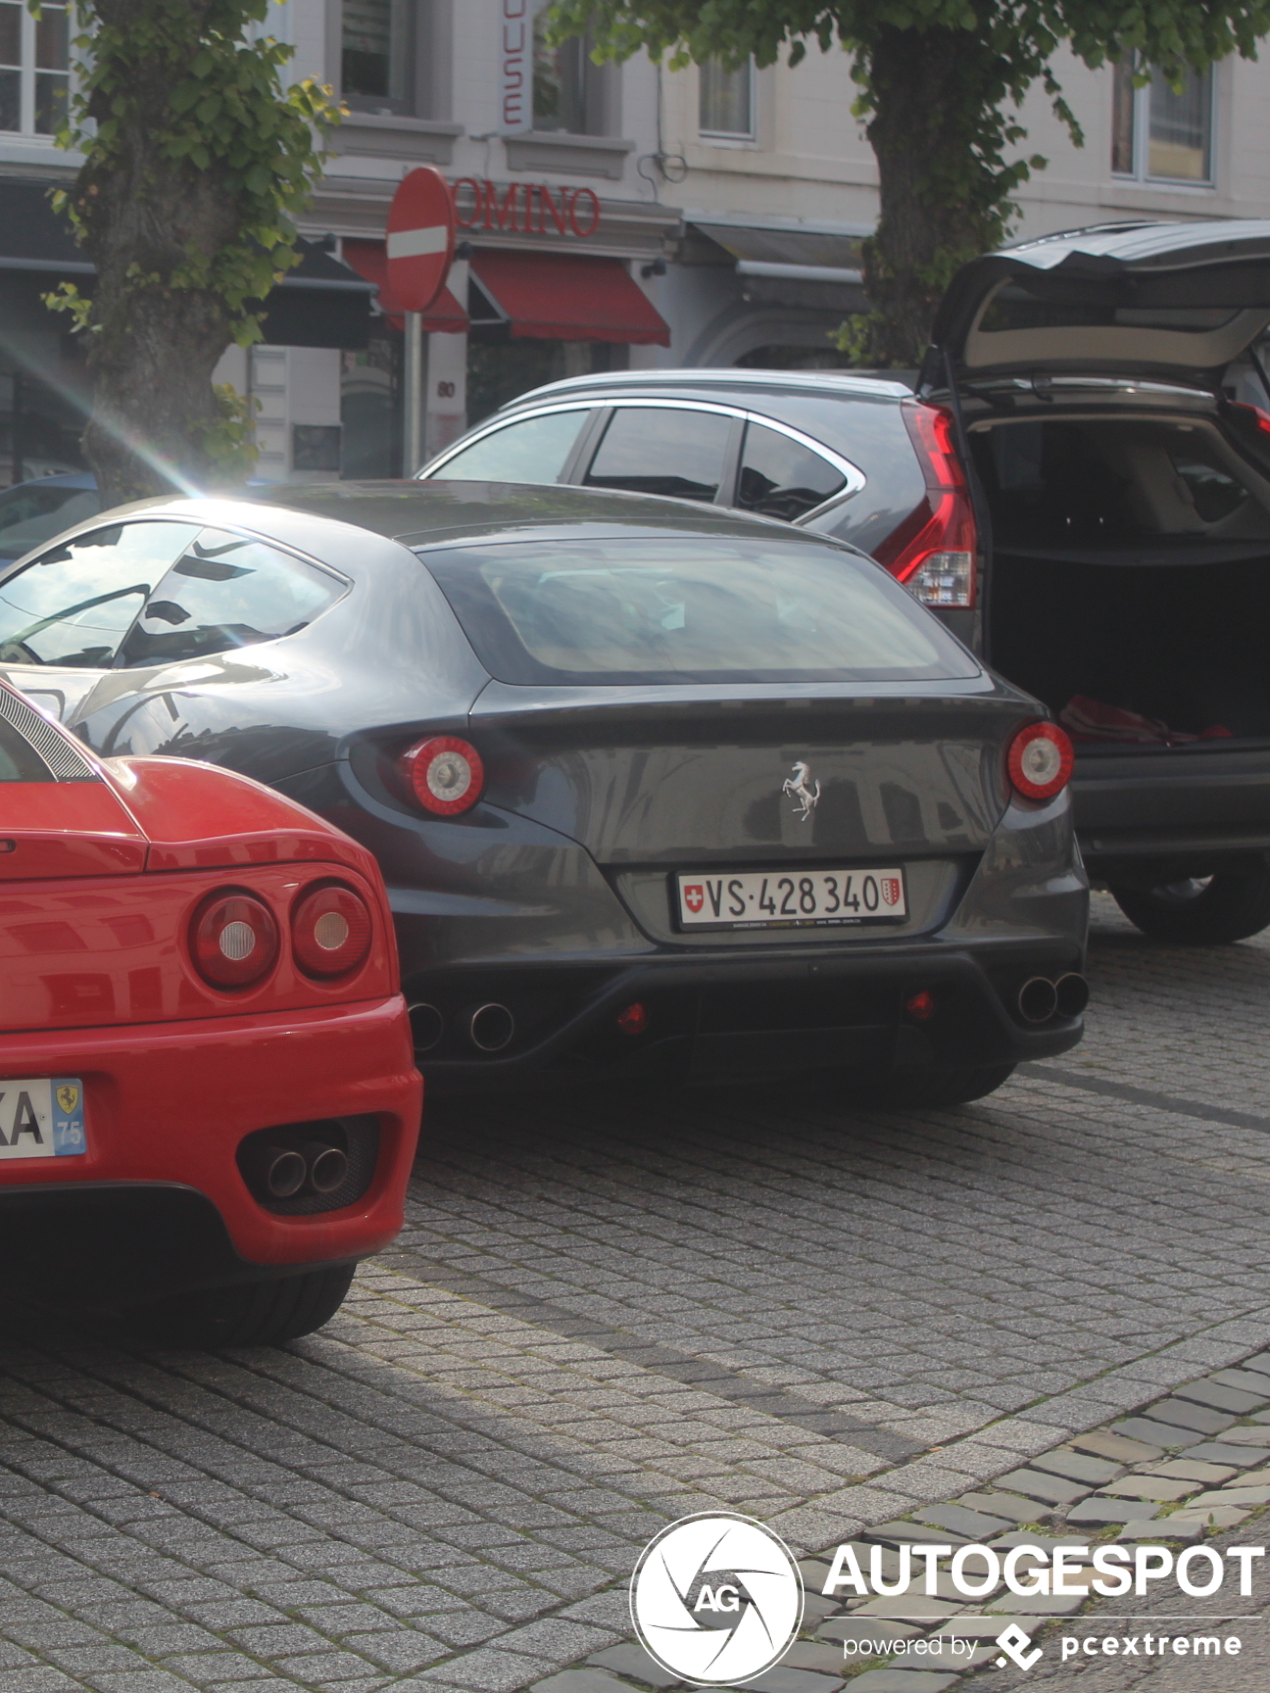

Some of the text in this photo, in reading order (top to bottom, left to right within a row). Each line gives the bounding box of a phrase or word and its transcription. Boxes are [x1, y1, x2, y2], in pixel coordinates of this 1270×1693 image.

[452, 178, 600, 238] OMINO
[437, 381, 455, 398] 80
[57, 1121, 82, 1145] 75
